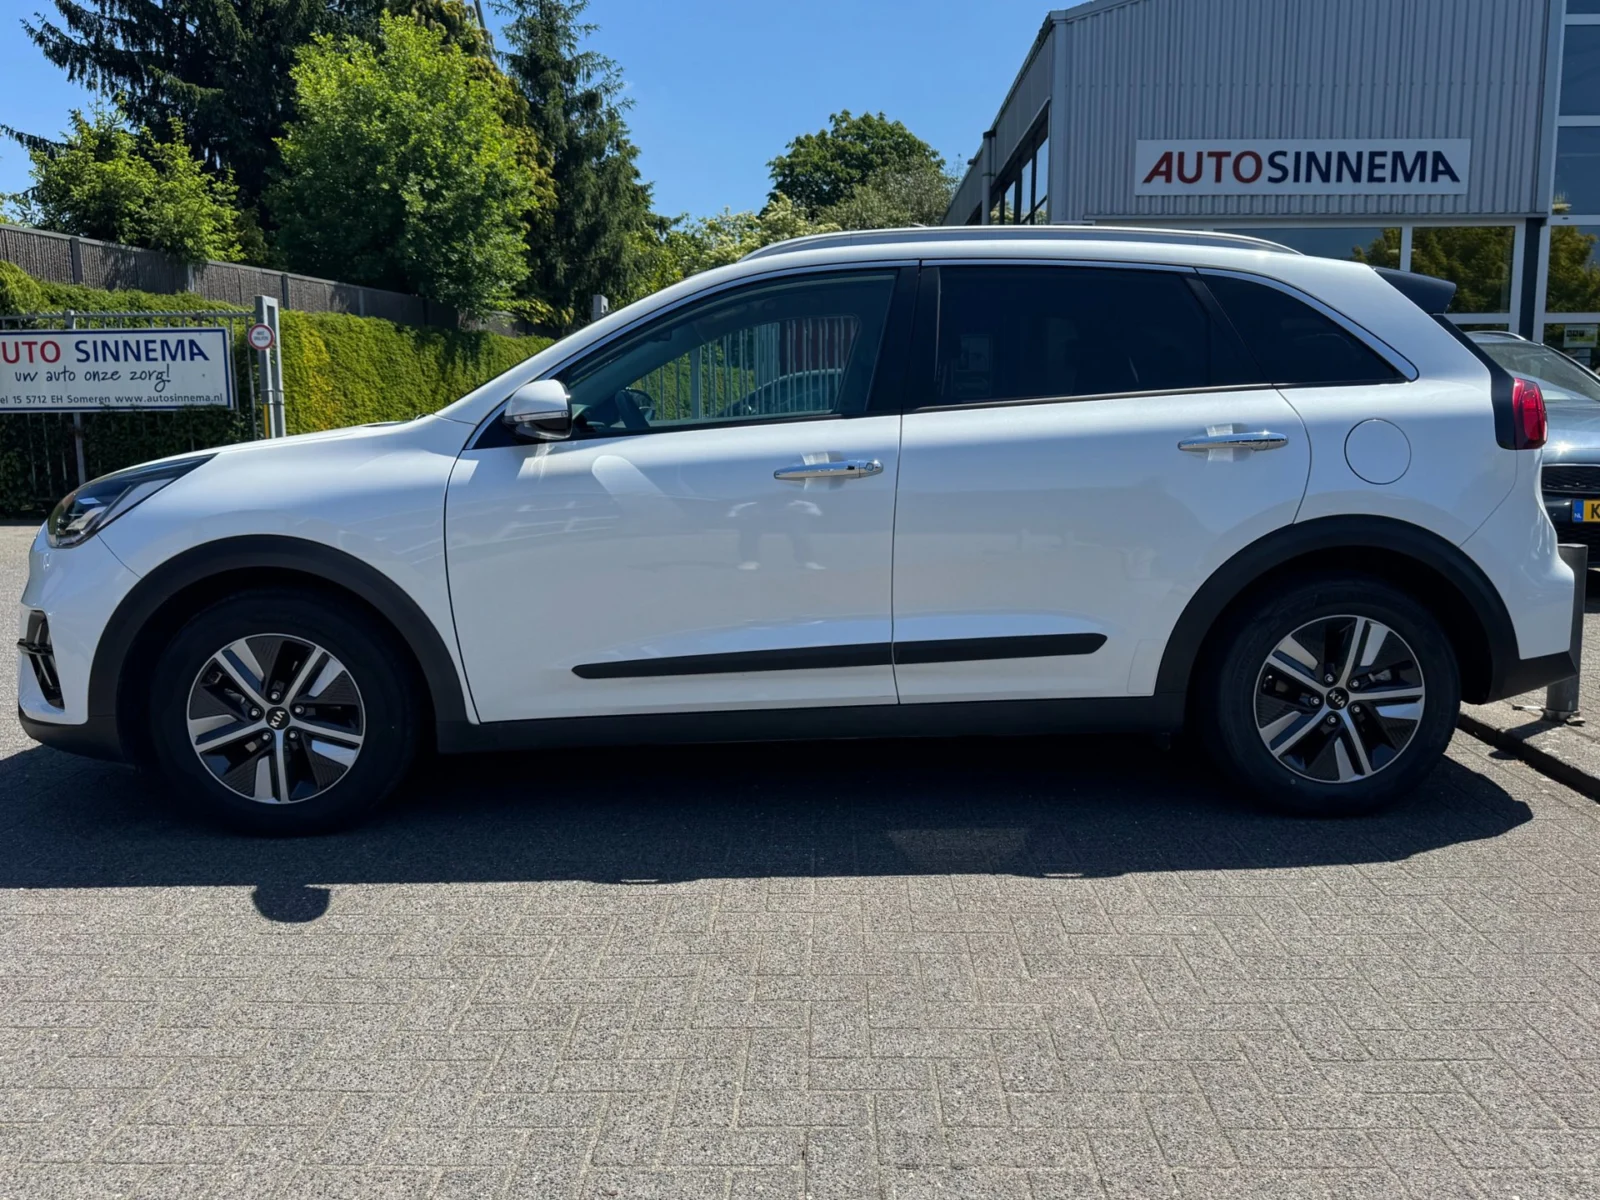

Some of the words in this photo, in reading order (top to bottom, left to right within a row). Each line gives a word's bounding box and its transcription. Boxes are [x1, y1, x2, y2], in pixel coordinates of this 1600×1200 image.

[74, 339, 210, 363] SINNEMA
[14, 371, 38, 383] uw
[45, 364, 76, 383] auto
[84, 370, 121, 382] onze
[129, 363, 171, 393] zorg!
[12, 395, 22, 404] 15
[26, 394, 47, 404] 5712
[50, 394, 63, 404] EH
[67, 394, 110, 403] Someren
[114, 393, 223, 403] www.autosinnema.nl
[1329, 690, 1345, 708] KIA
[269, 711, 285, 728] KIA
